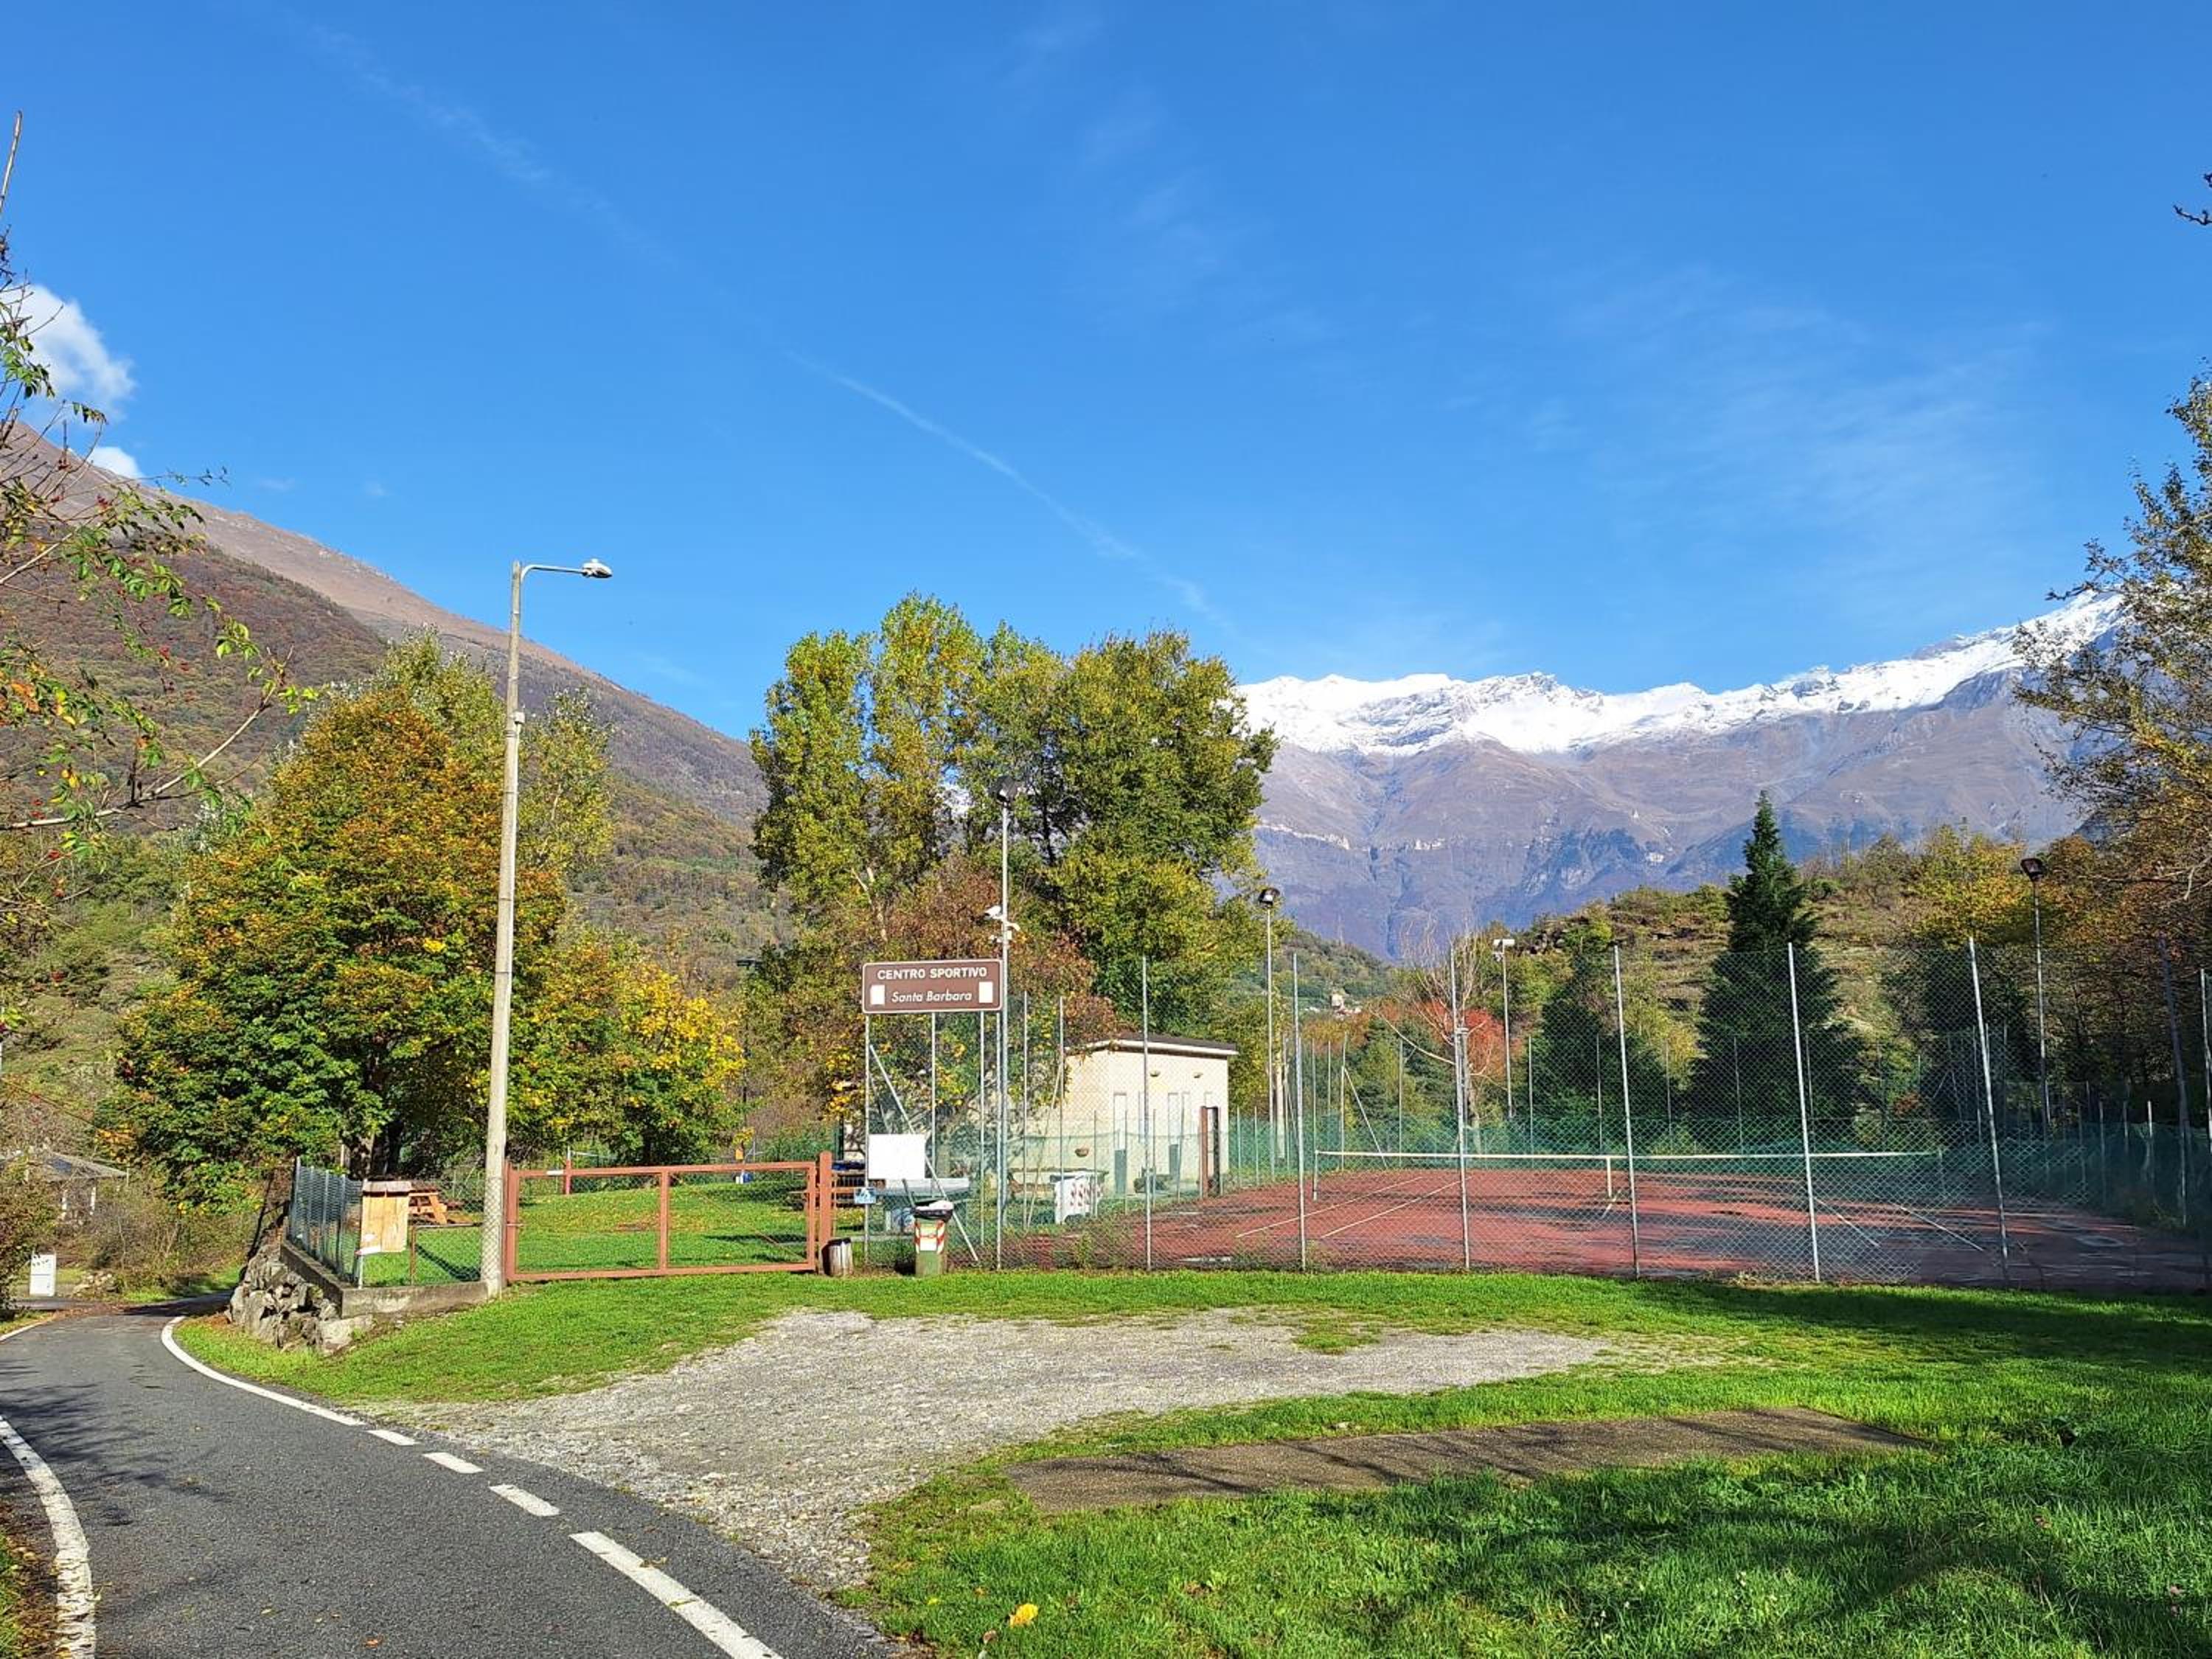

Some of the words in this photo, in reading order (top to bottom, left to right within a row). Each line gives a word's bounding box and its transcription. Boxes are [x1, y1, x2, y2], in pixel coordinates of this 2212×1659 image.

[877, 969, 926, 980] CENTRO
[930, 967, 987, 978] SPORTIVO
[891, 991, 922, 1003] Santa
[926, 988, 973, 1001] Barbara
